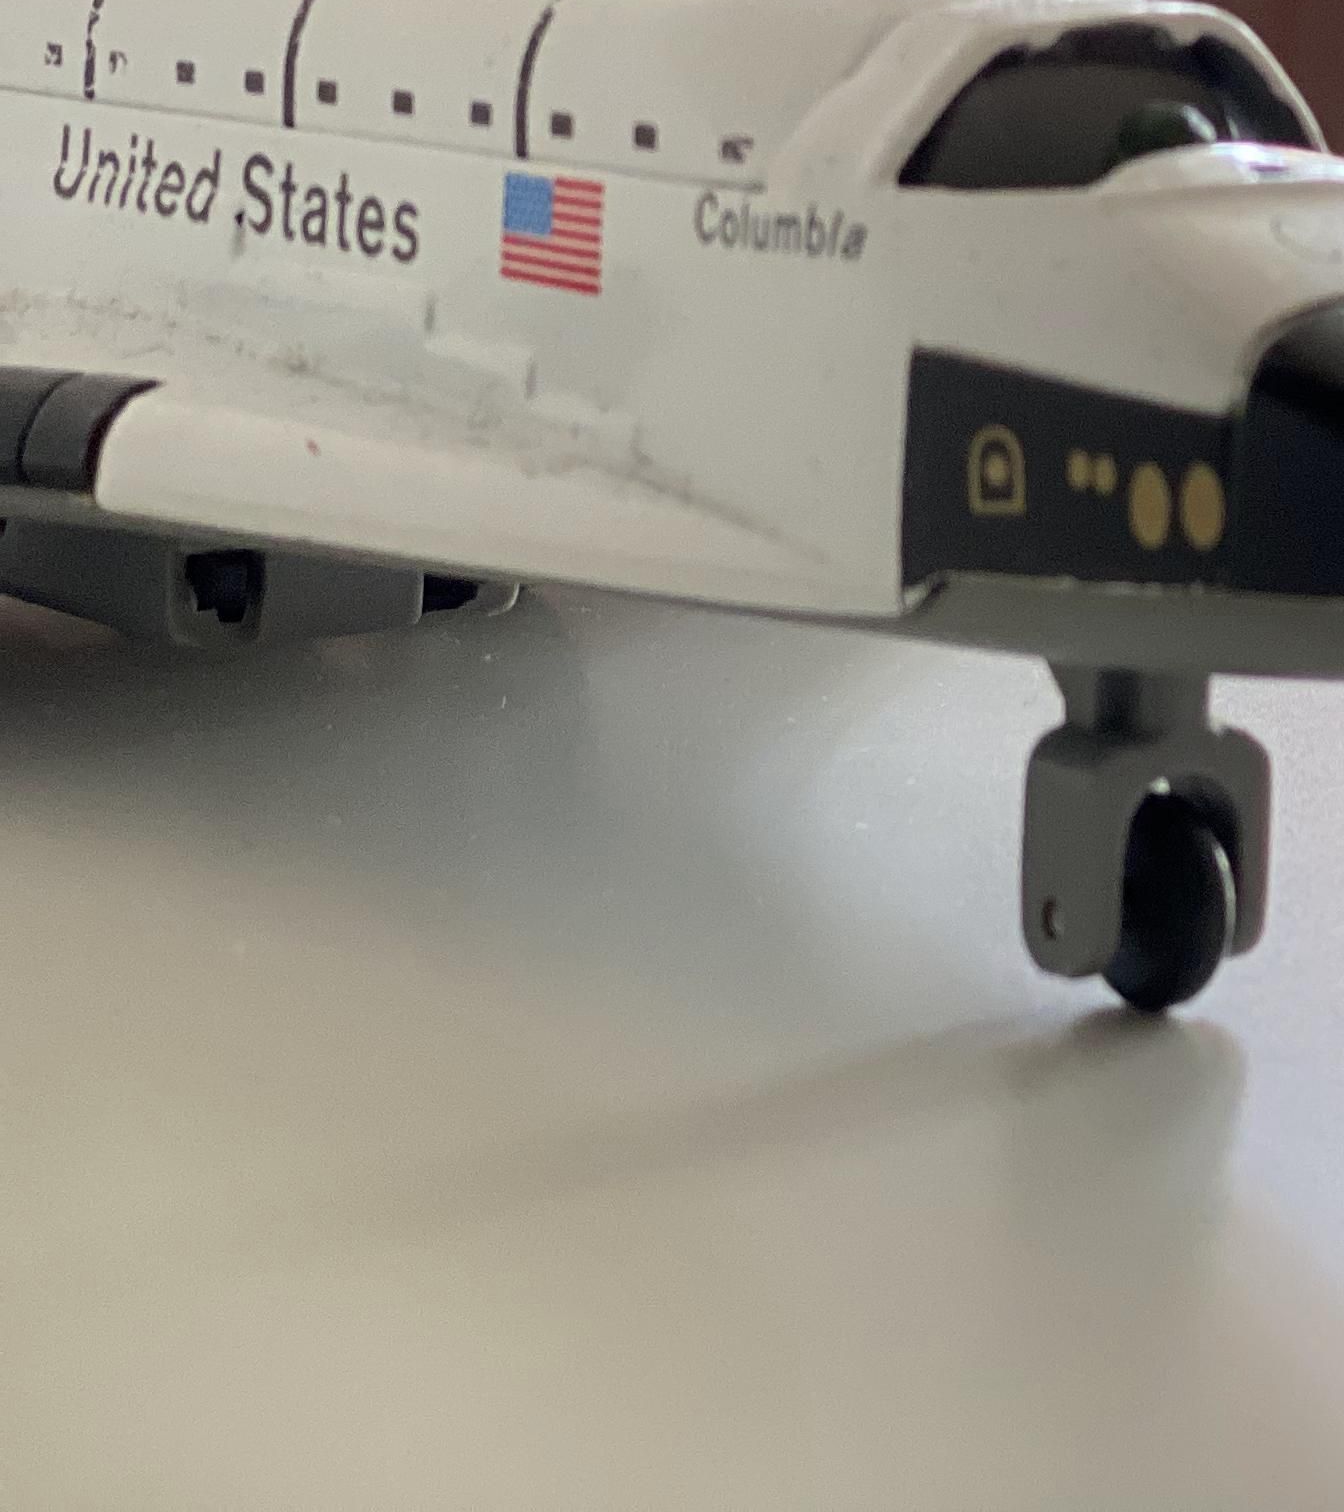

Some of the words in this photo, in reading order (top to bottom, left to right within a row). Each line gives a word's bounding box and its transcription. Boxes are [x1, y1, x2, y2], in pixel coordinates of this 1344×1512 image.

[53, 125, 222, 222] United
[242, 153, 420, 262] States
[695, 191, 868, 261] Columbia
